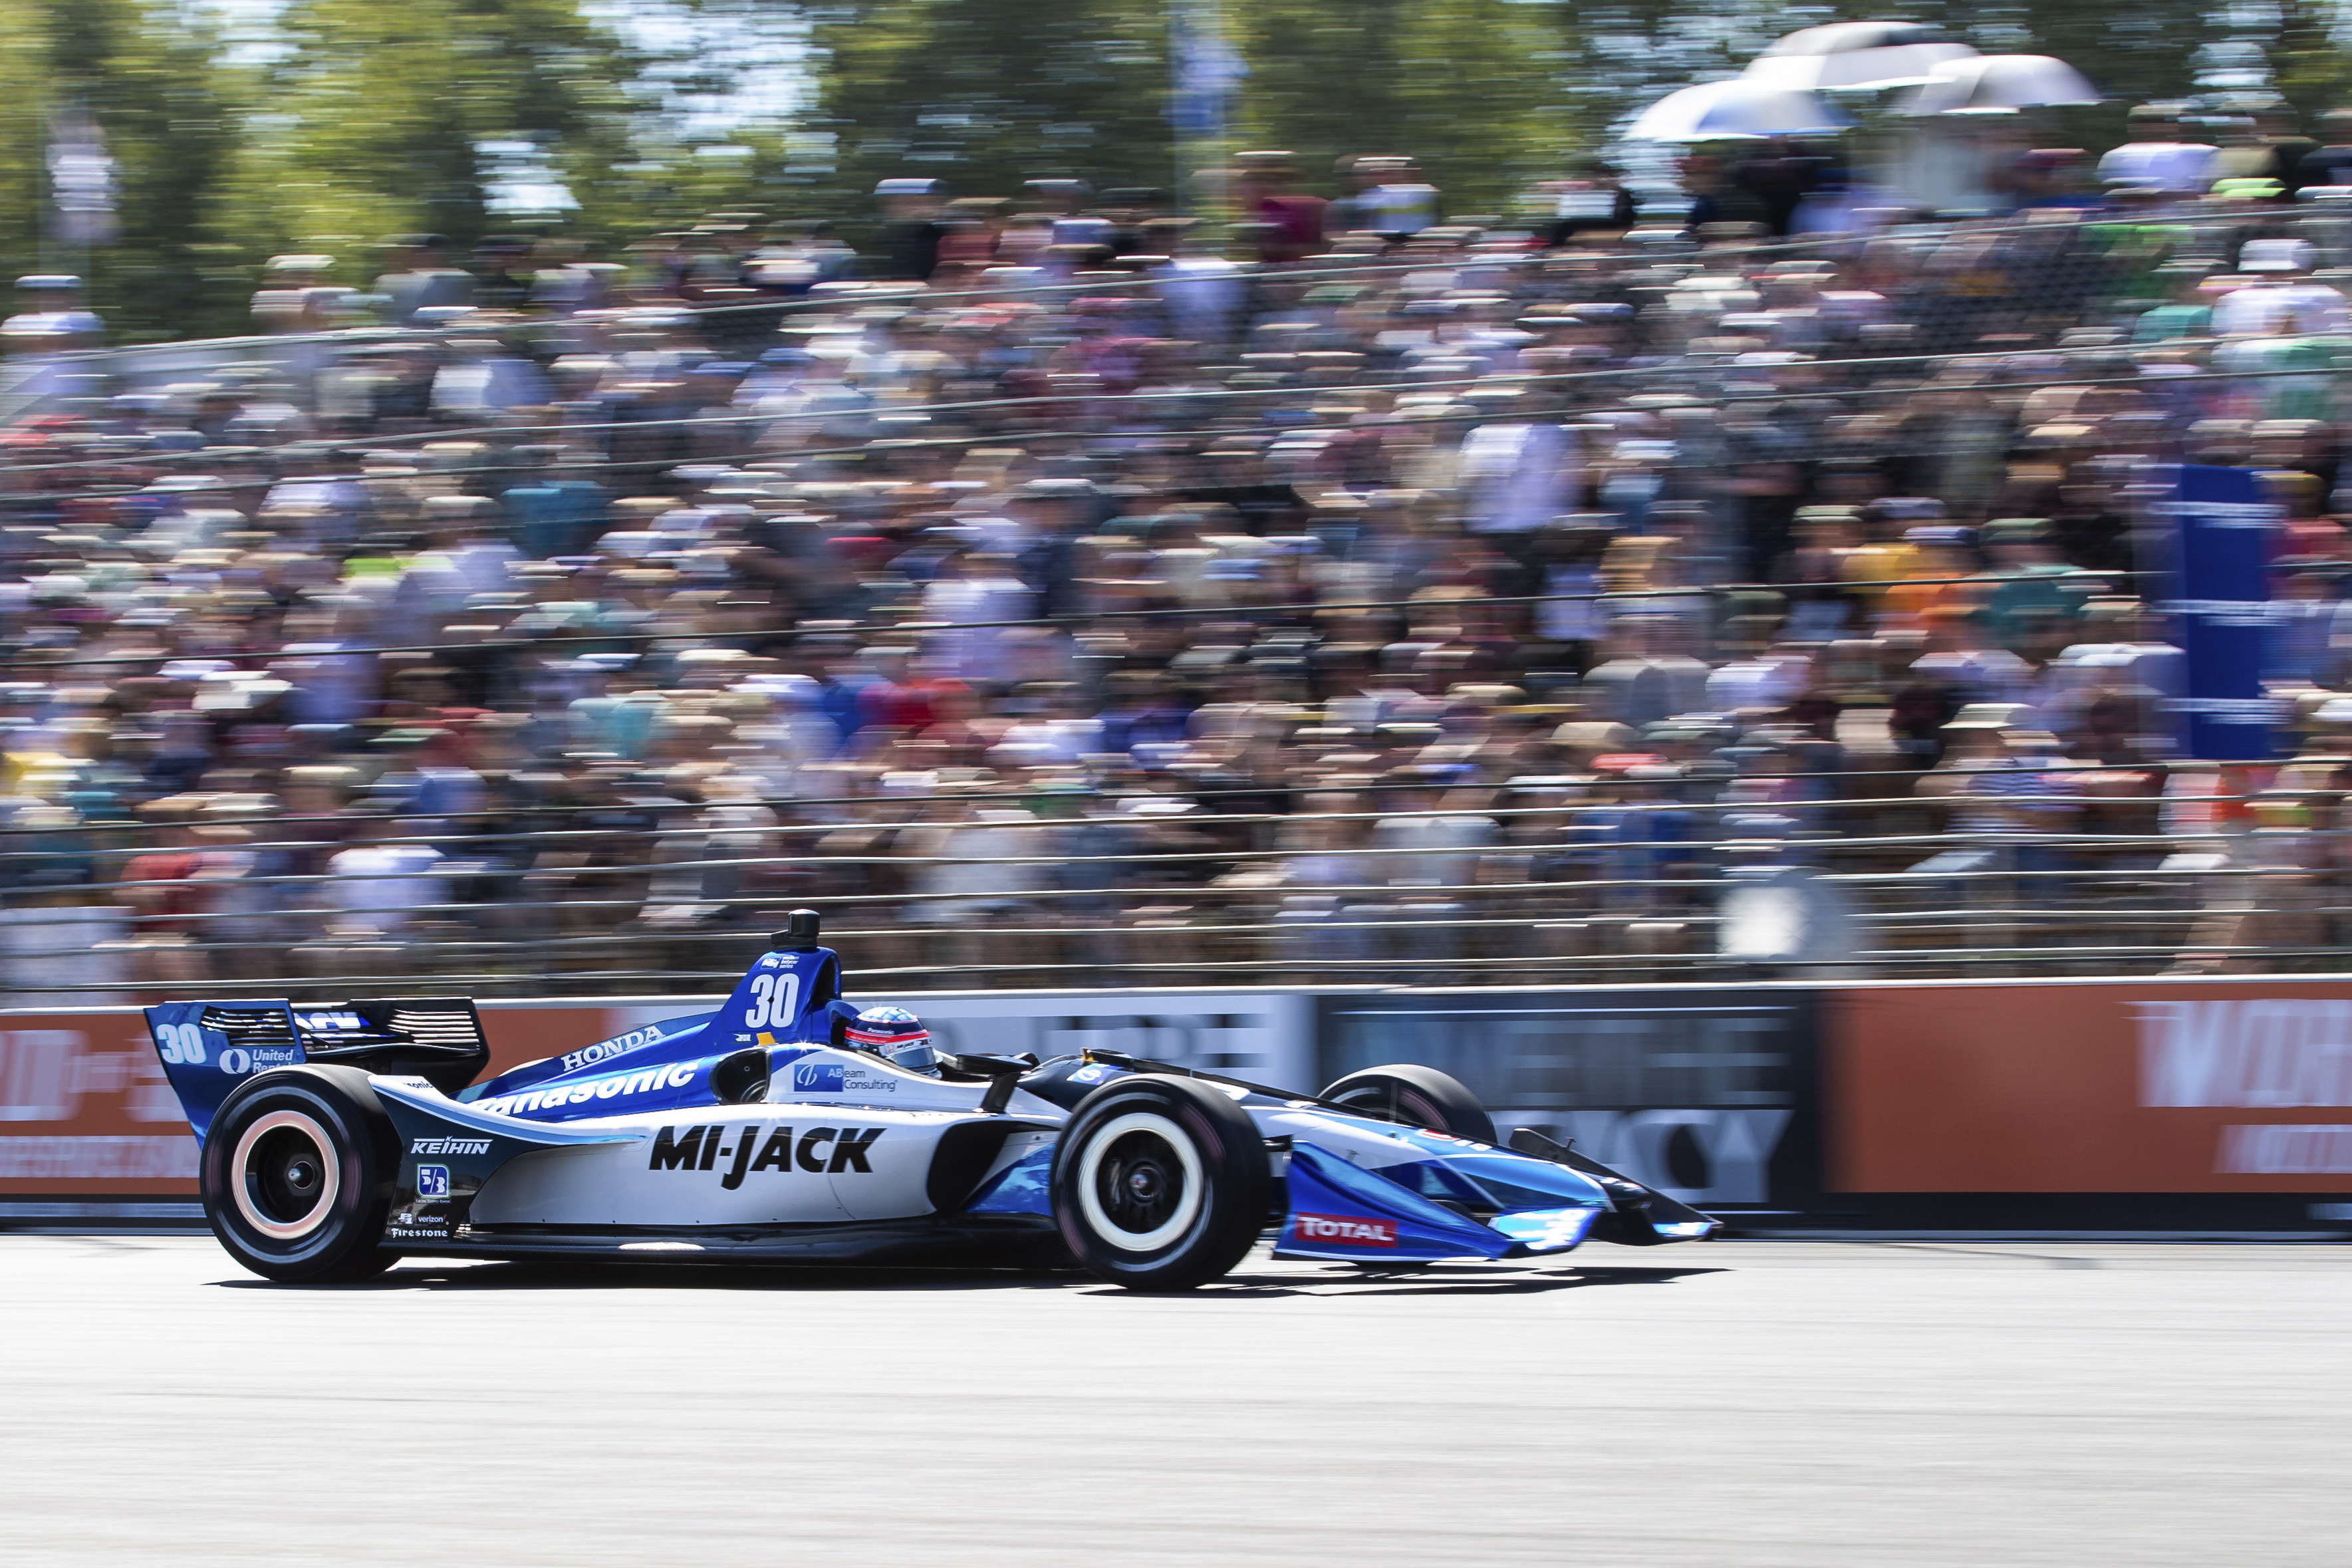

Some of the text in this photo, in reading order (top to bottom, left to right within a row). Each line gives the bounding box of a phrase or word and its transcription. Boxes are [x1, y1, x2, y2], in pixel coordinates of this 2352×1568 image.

[745, 973, 799, 1028] 30
[156, 1023, 206, 1063] 30
[561, 1025, 666, 1071] HONDA
[253, 1049, 294, 1061] United
[827, 1068, 866, 1078] ABeam
[844, 1079, 896, 1092] Consulting
[411, 1142, 490, 1154] KEIHIN
[648, 1125, 888, 1191] MI-JACK
[391, 1228, 448, 1238] Firestone
[1297, 1216, 1394, 1241] TOTAL
